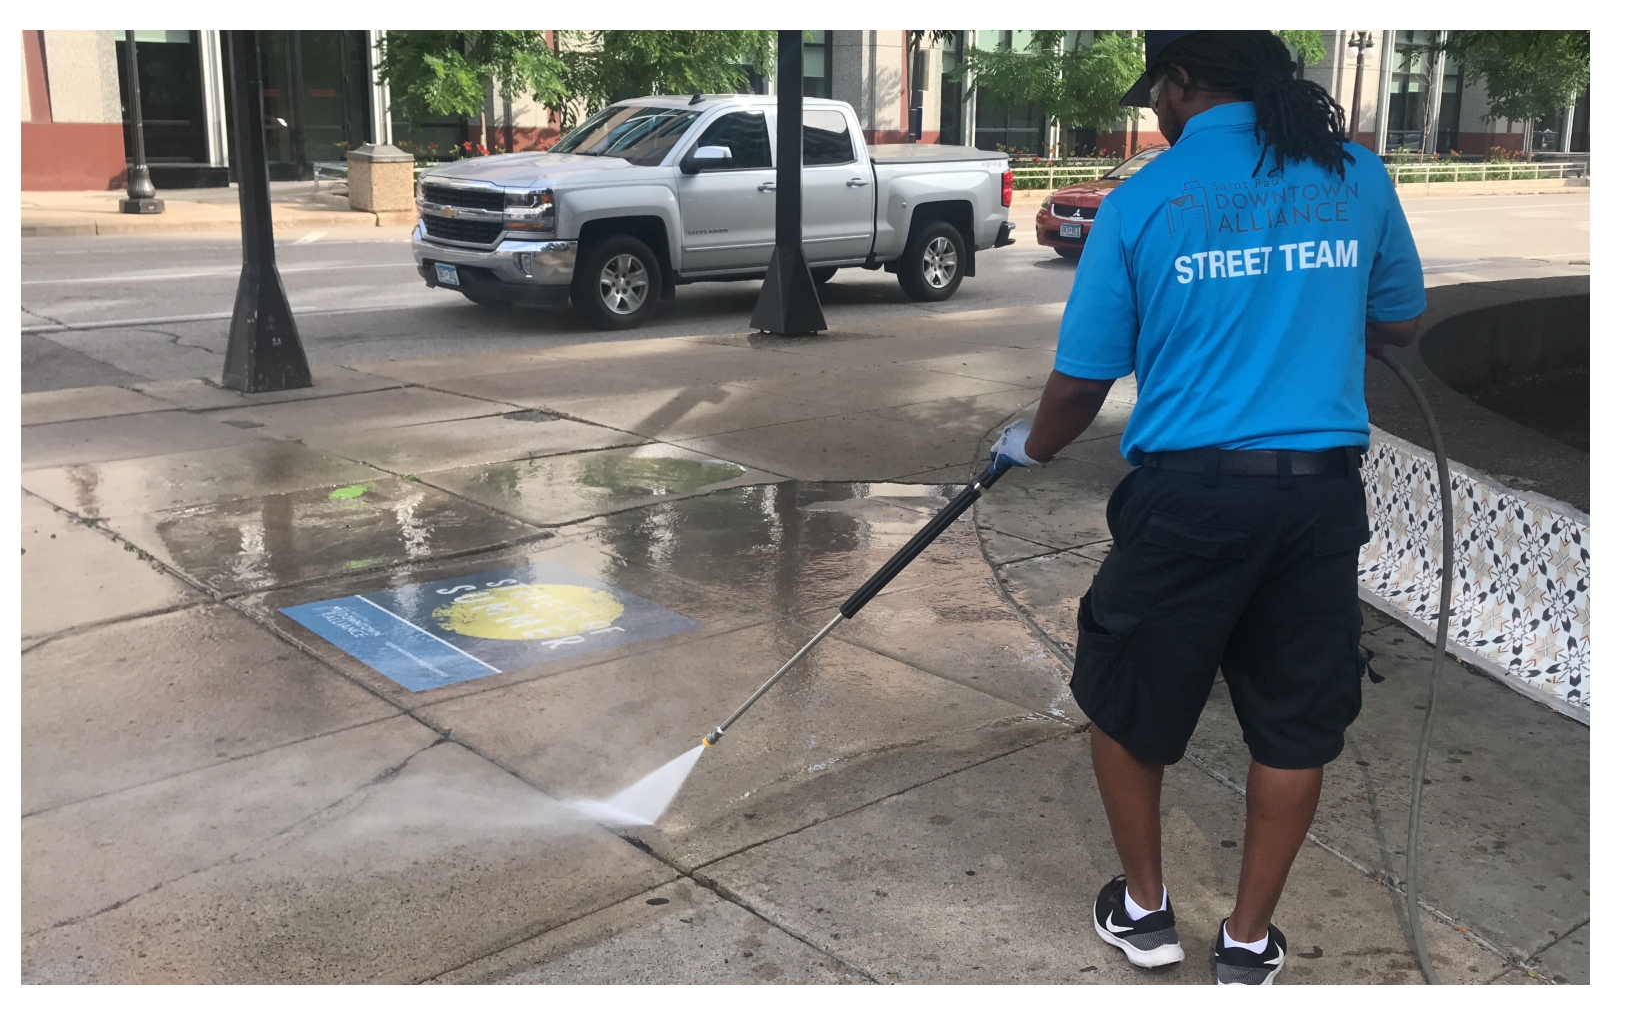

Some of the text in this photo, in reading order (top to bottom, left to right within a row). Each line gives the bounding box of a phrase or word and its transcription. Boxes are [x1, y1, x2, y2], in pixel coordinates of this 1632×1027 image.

[1212, 177, 1286, 191] Saint Paul
[1214, 182, 1359, 210] DOWNTOWN
[1218, 201, 1349, 233] ALLIANCE
[1174, 239, 1359, 284] STREET TEAM
[436, 584, 586, 649] SUMMER
[485, 578, 626, 636] STREETS OF
